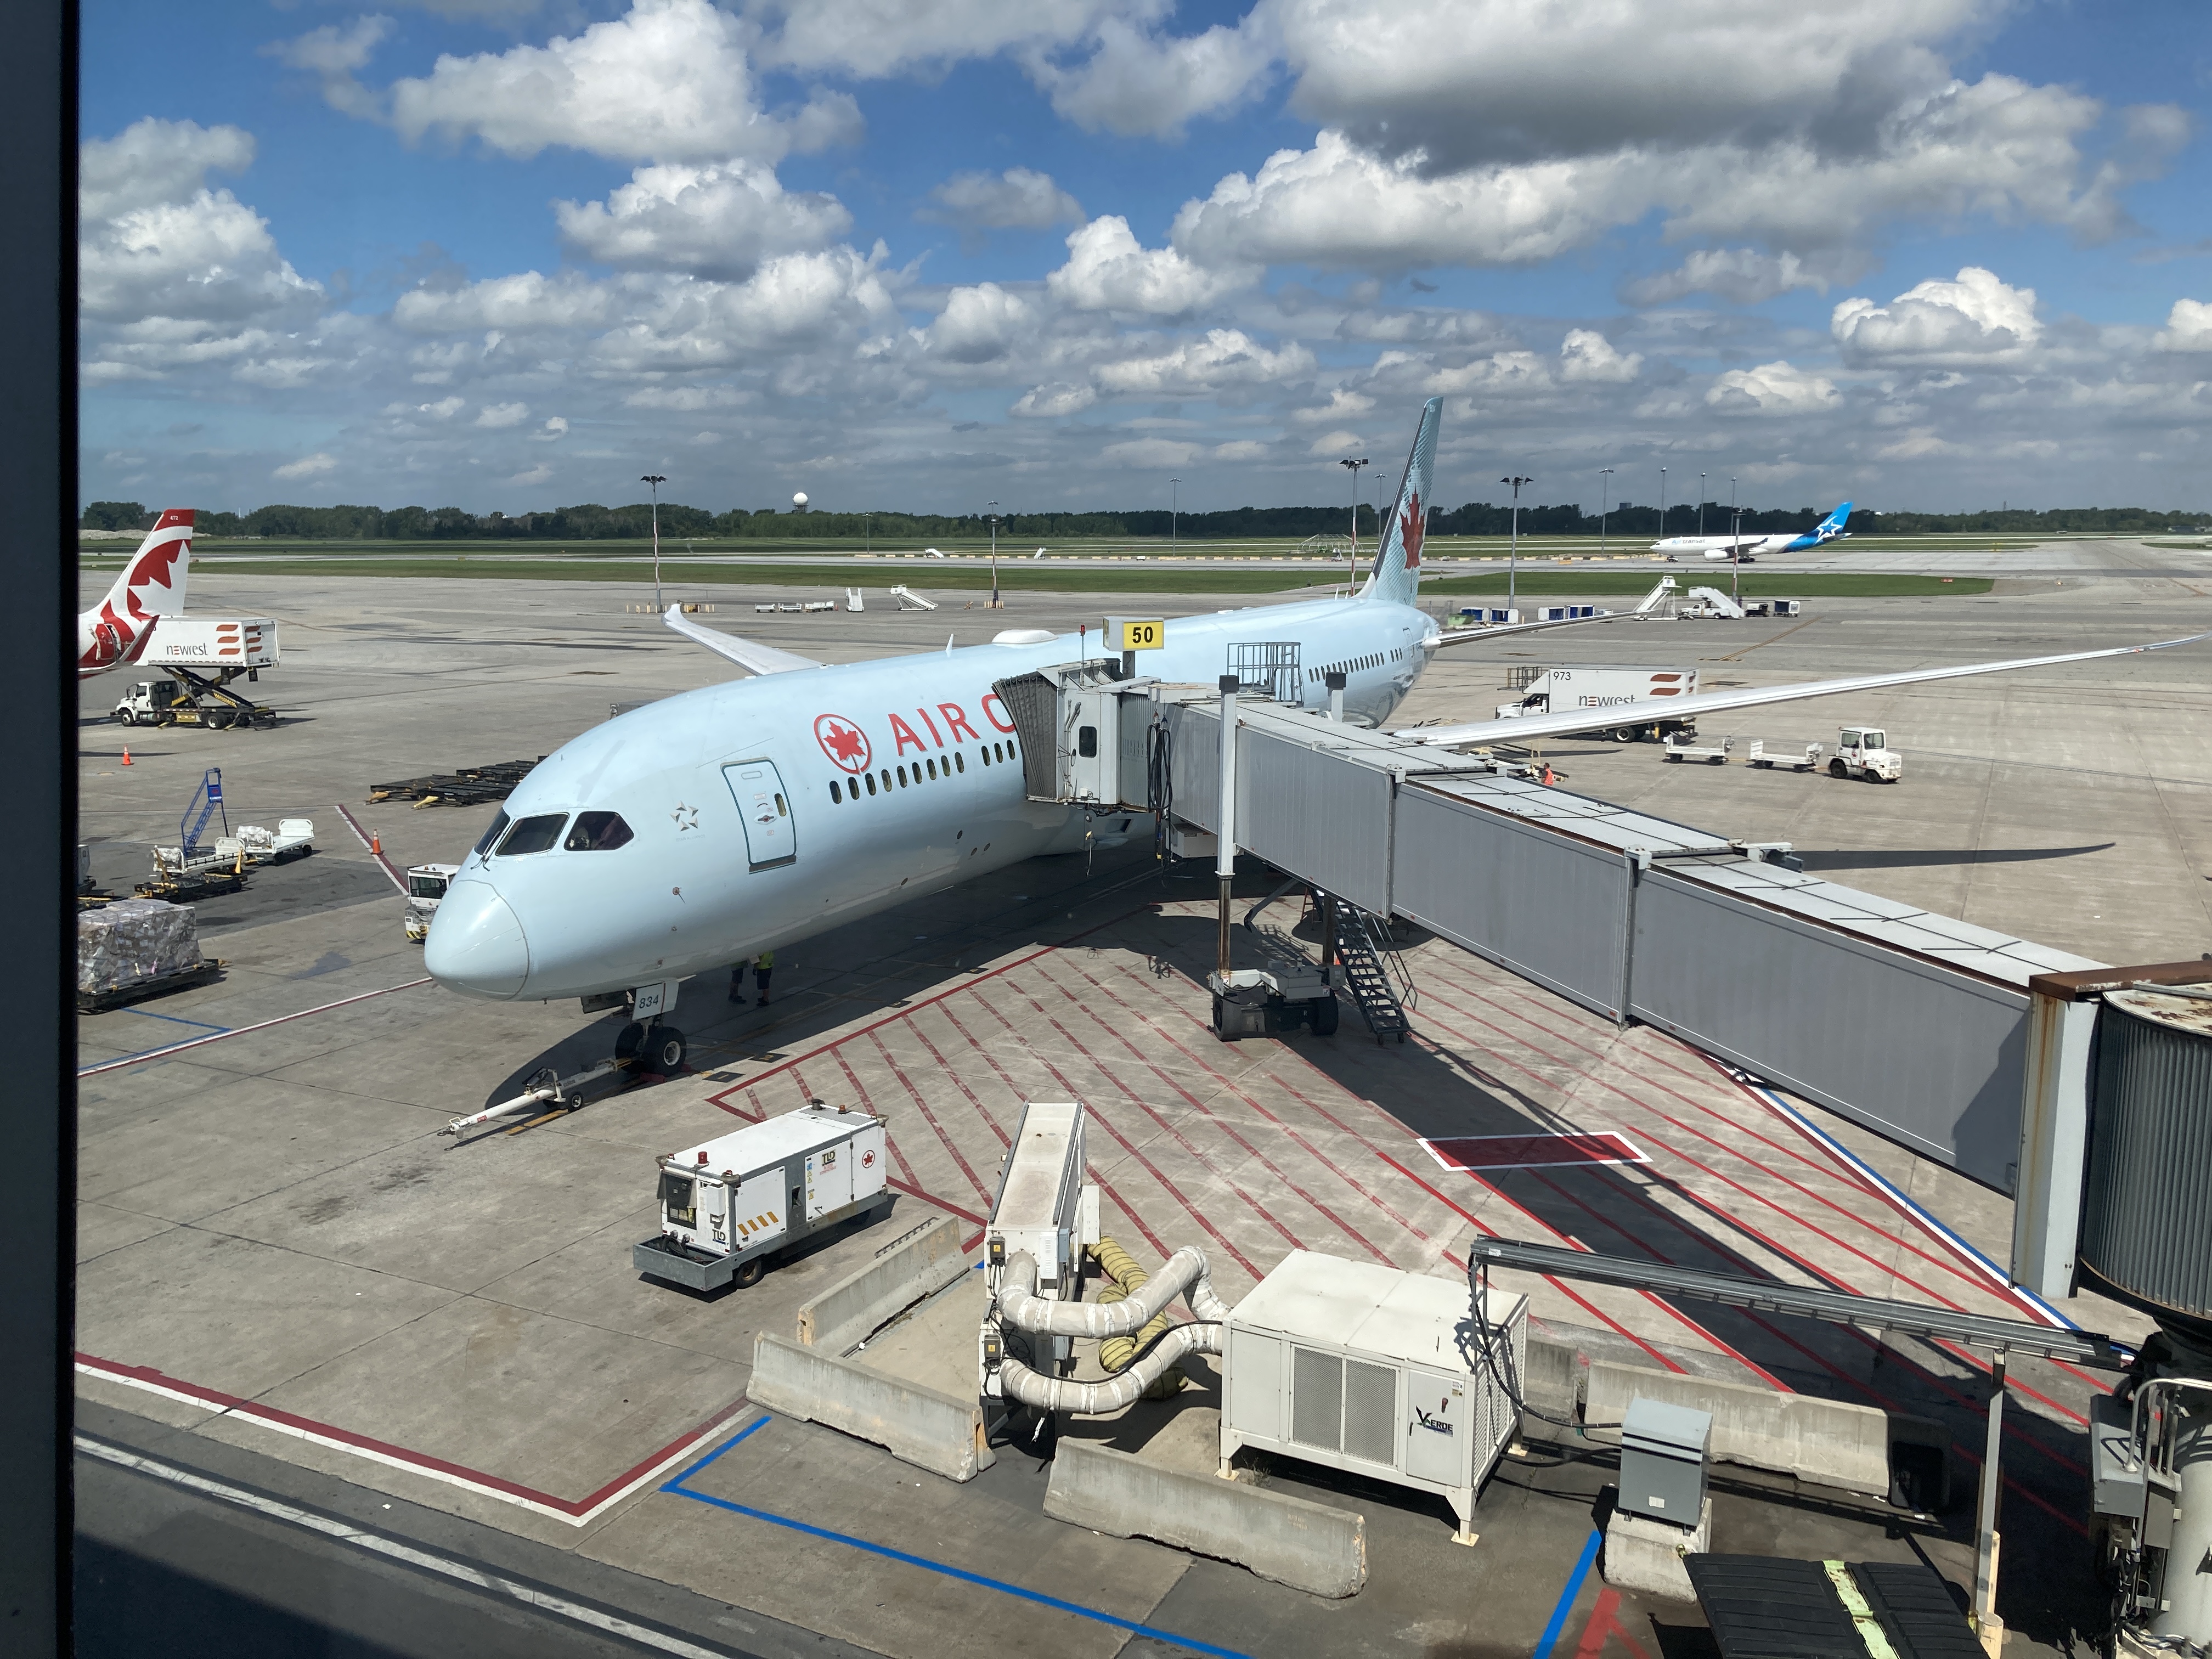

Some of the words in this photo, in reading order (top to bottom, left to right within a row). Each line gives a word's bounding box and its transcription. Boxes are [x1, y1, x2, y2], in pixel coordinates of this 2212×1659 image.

[1132, 626, 1153, 644] 50
[166, 642, 208, 656] newrest
[1553, 672, 1571, 681] 973
[888, 703, 981, 757] AIR
[639, 995, 659, 1009] 834
[822, 1150, 836, 1164] TLD
[712, 1229, 726, 1242] TLD
[1416, 1406, 1453, 1431] VERDE
